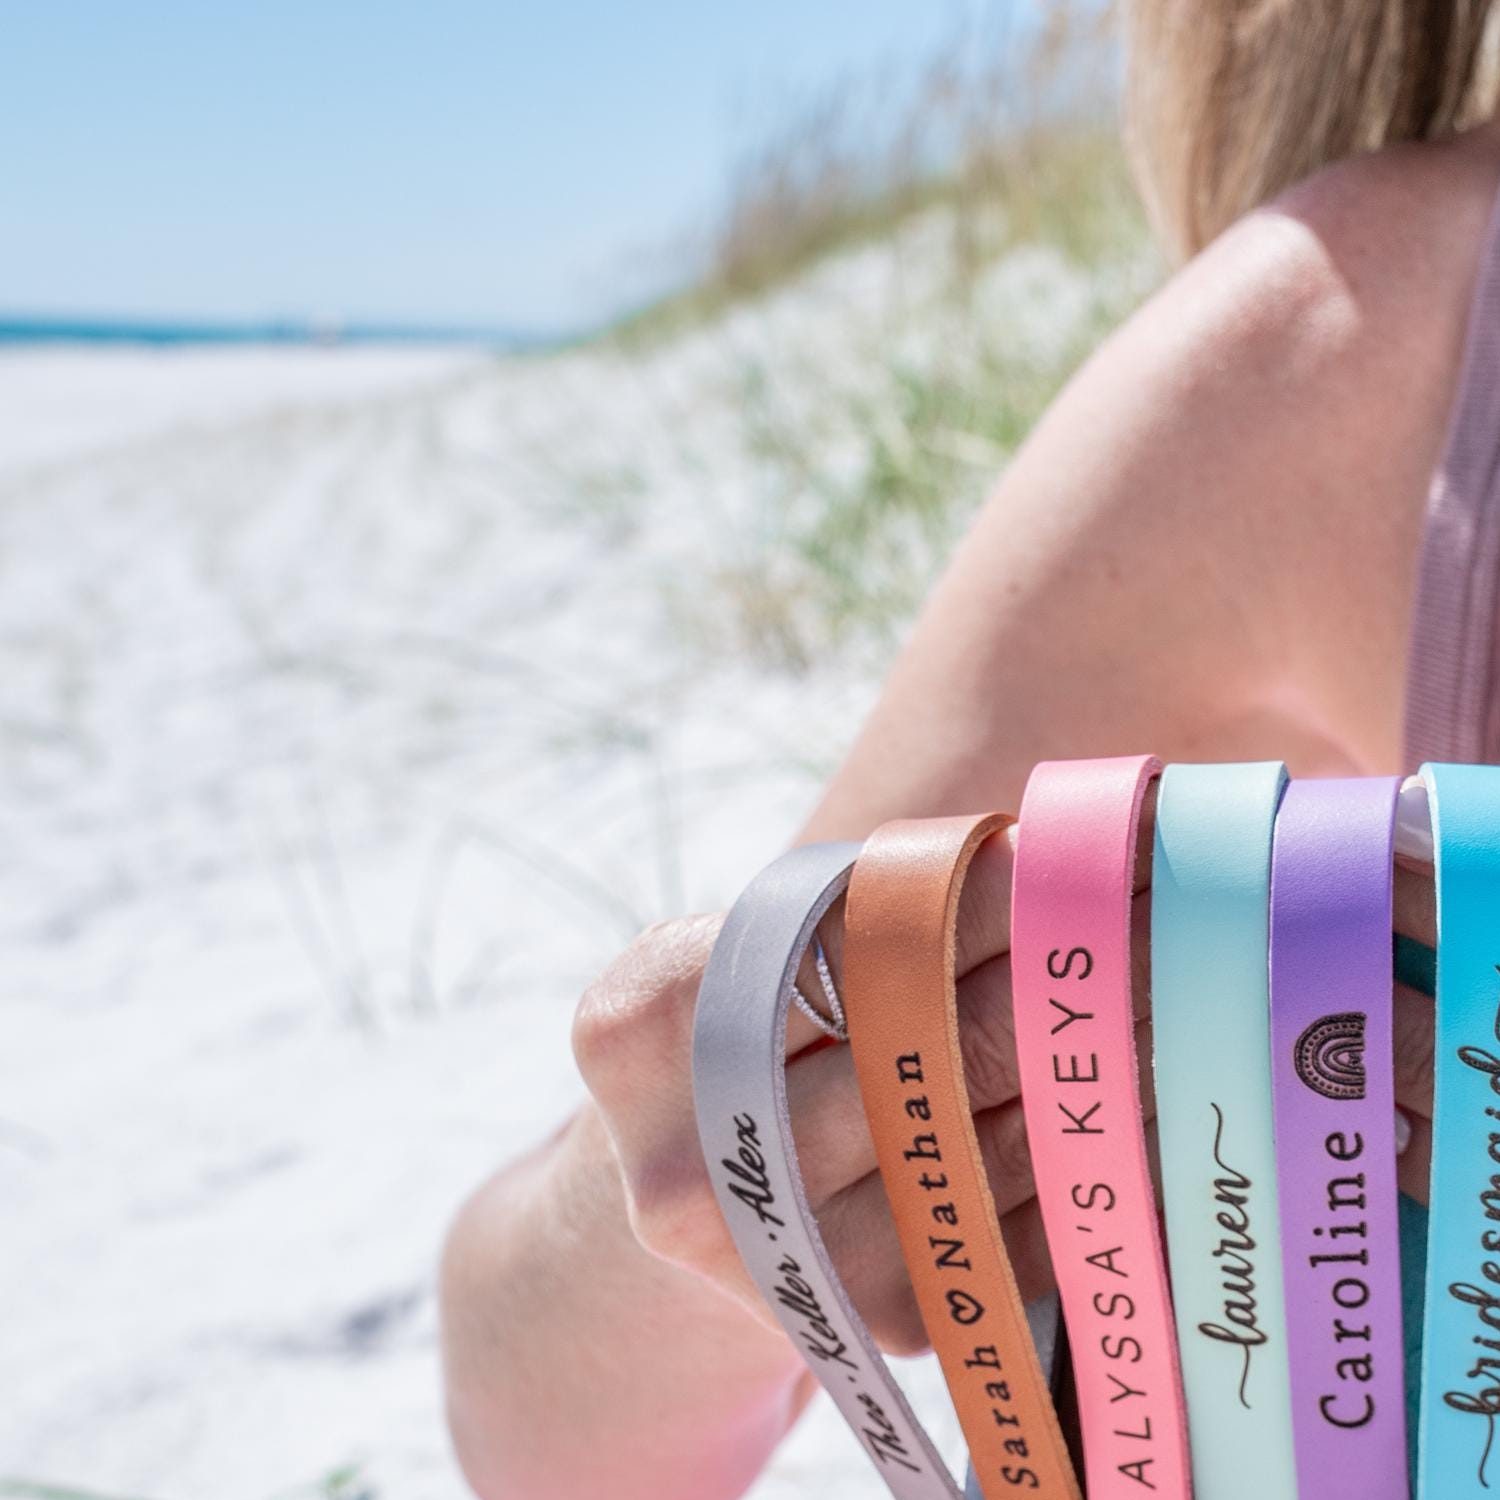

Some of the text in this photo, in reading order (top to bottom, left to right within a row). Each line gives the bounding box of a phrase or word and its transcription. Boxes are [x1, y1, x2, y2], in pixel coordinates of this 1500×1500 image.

[721, 1111, 786, 1228] Alex
[773, 1253, 859, 1371] Keller
[896, 1051, 1041, 1489] Sarah Nathan
[1047, 946, 1157, 1490] ALYSSA'S KEYS
[1198, 1102, 1267, 1409] lauren
[1310, 1130, 1376, 1429] Caroline
